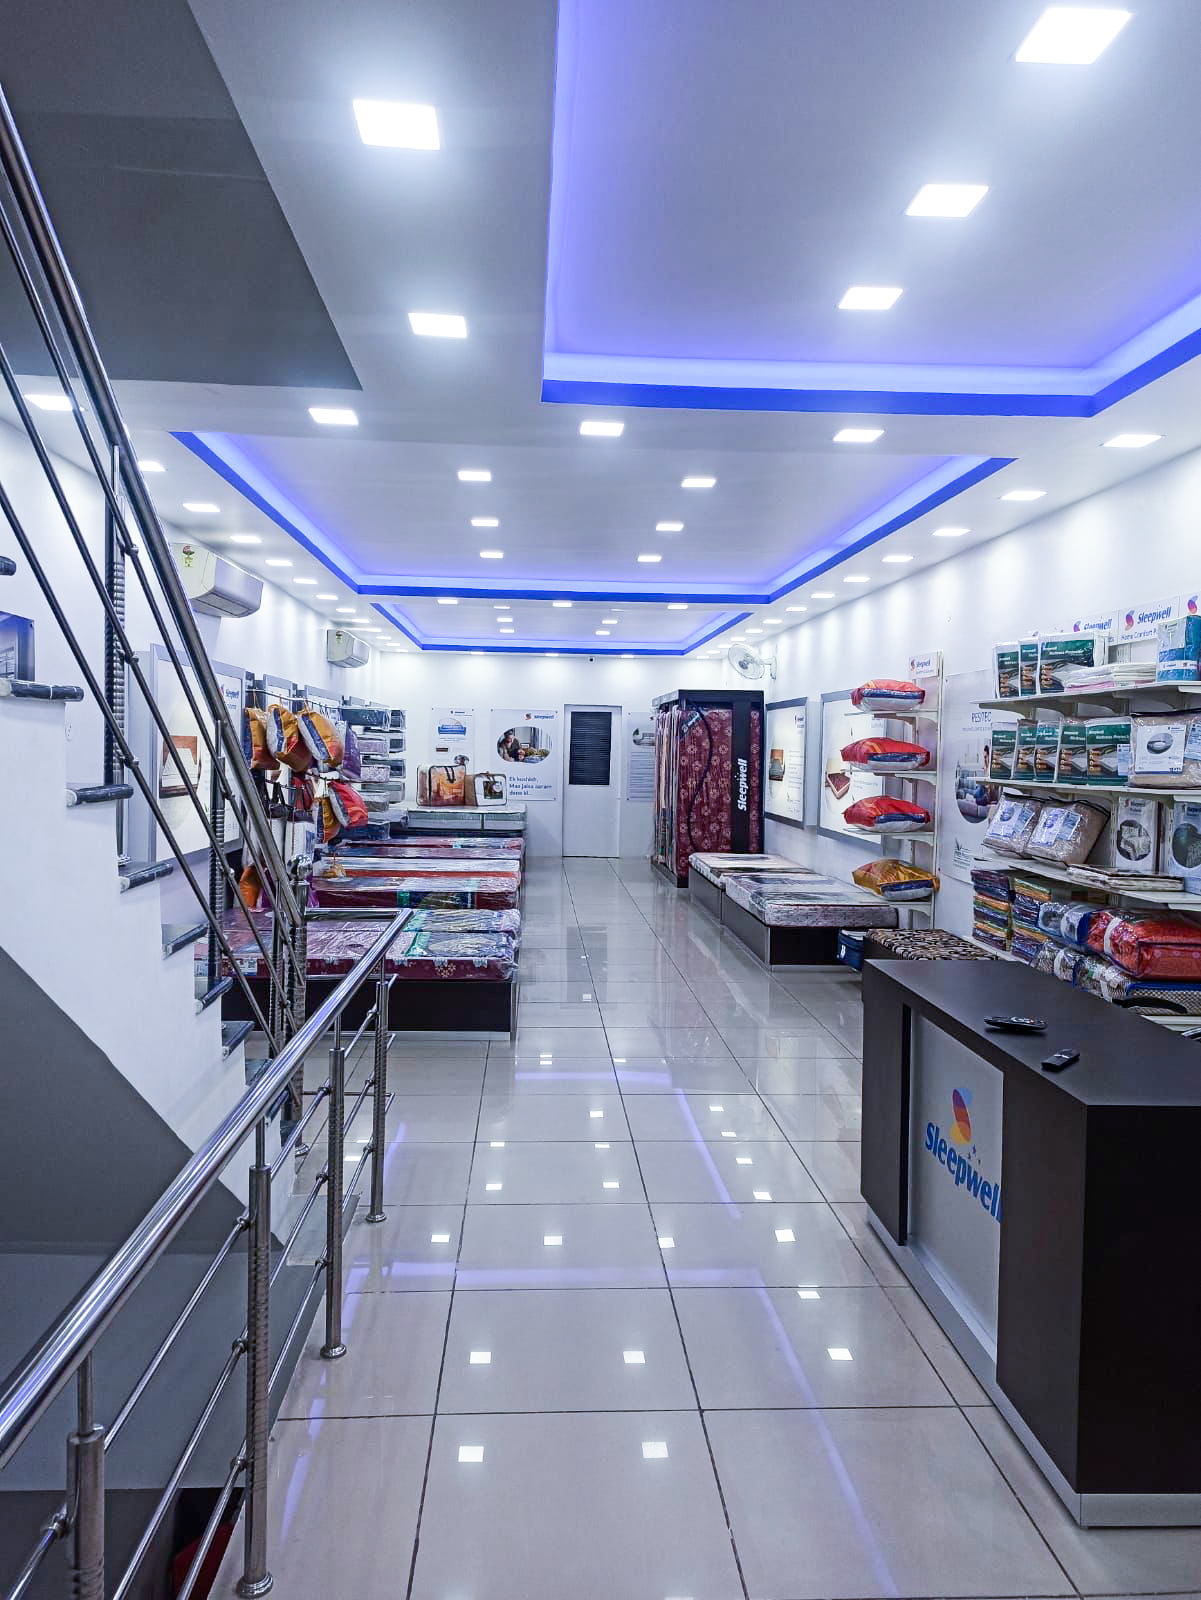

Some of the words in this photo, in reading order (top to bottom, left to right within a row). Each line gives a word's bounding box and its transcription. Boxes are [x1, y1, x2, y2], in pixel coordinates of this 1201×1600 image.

[1137, 606, 1172, 624] Sleepwell
[737, 758, 749, 812] Sleepwell
[925, 1121, 1003, 1224] Sleepwell
